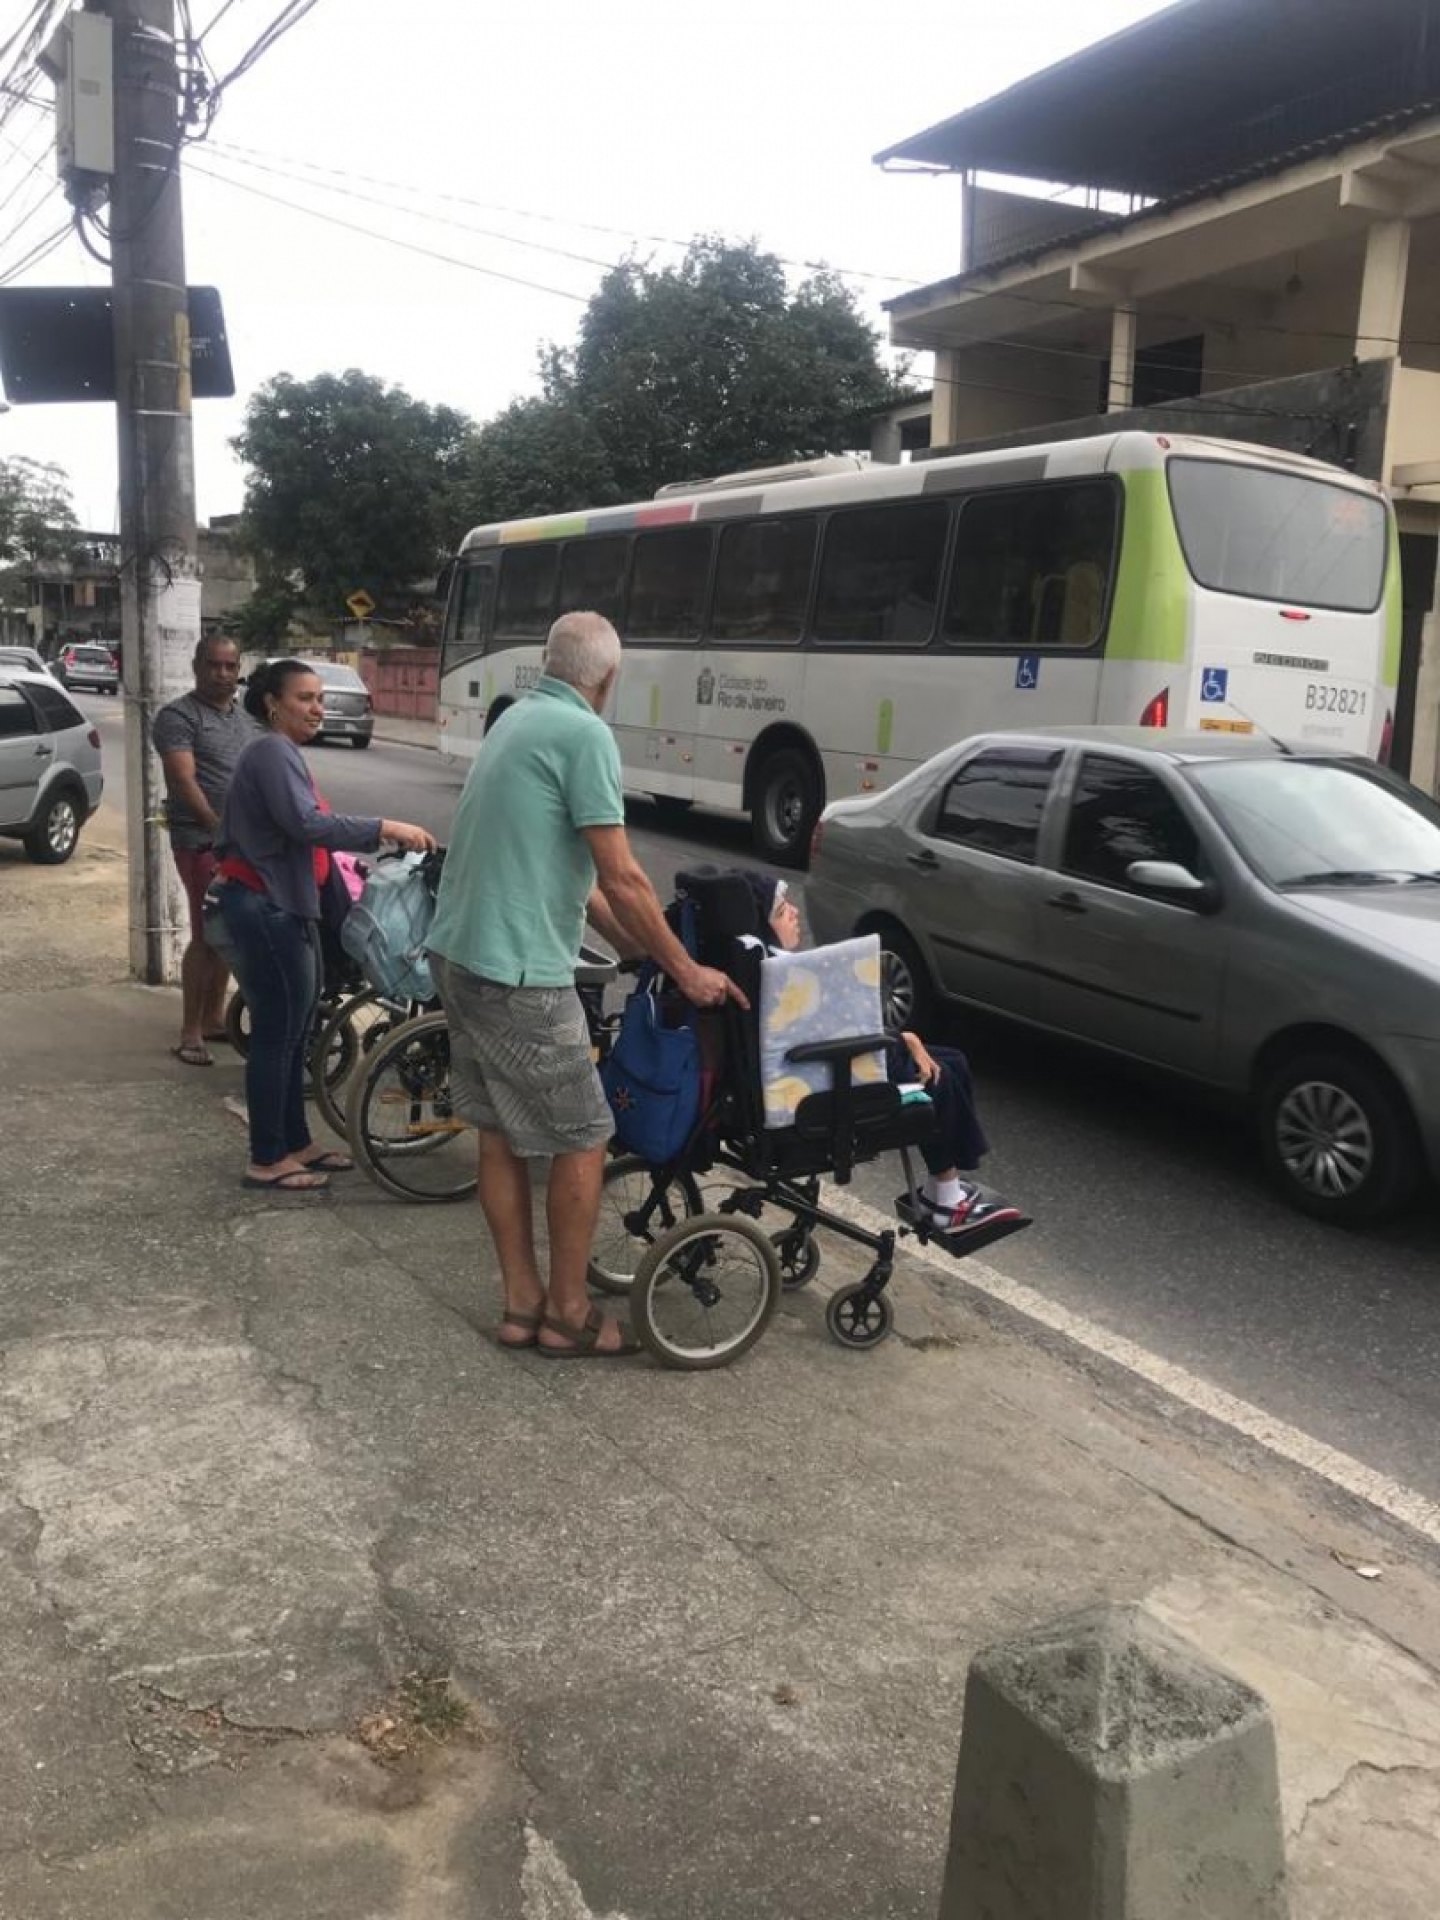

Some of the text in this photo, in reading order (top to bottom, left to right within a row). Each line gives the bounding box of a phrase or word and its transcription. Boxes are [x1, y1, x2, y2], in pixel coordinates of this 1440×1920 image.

[718, 691, 786, 712] Rio de Janeiro
[1305, 684, 1366, 715] B32821
